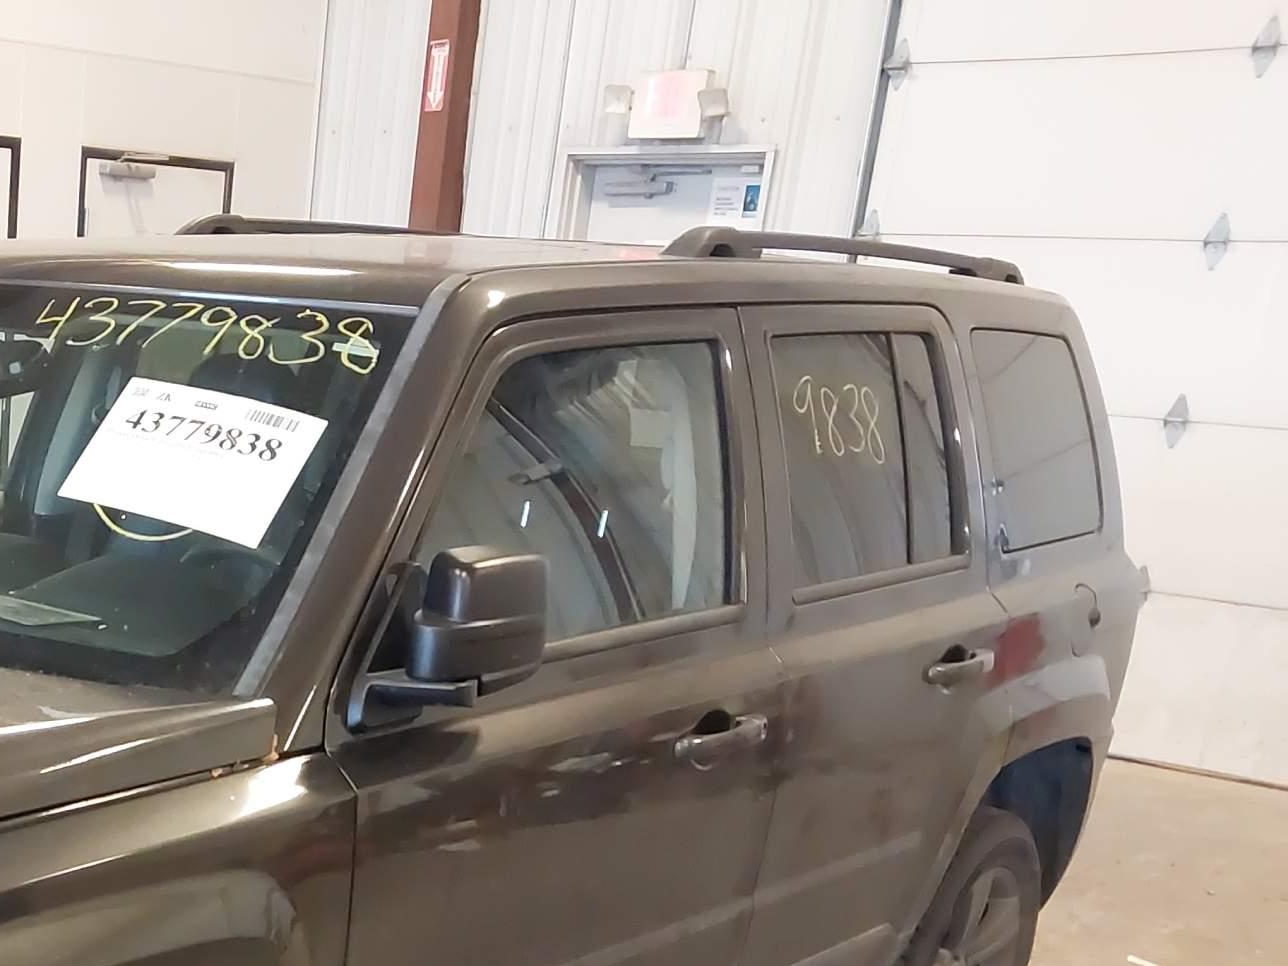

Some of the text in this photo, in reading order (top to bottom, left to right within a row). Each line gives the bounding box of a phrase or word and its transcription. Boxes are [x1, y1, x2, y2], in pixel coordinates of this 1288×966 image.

[36, 296, 380, 374] 43779838
[125, 409, 283, 461] 43779838
[793, 375, 885, 464] 9838
